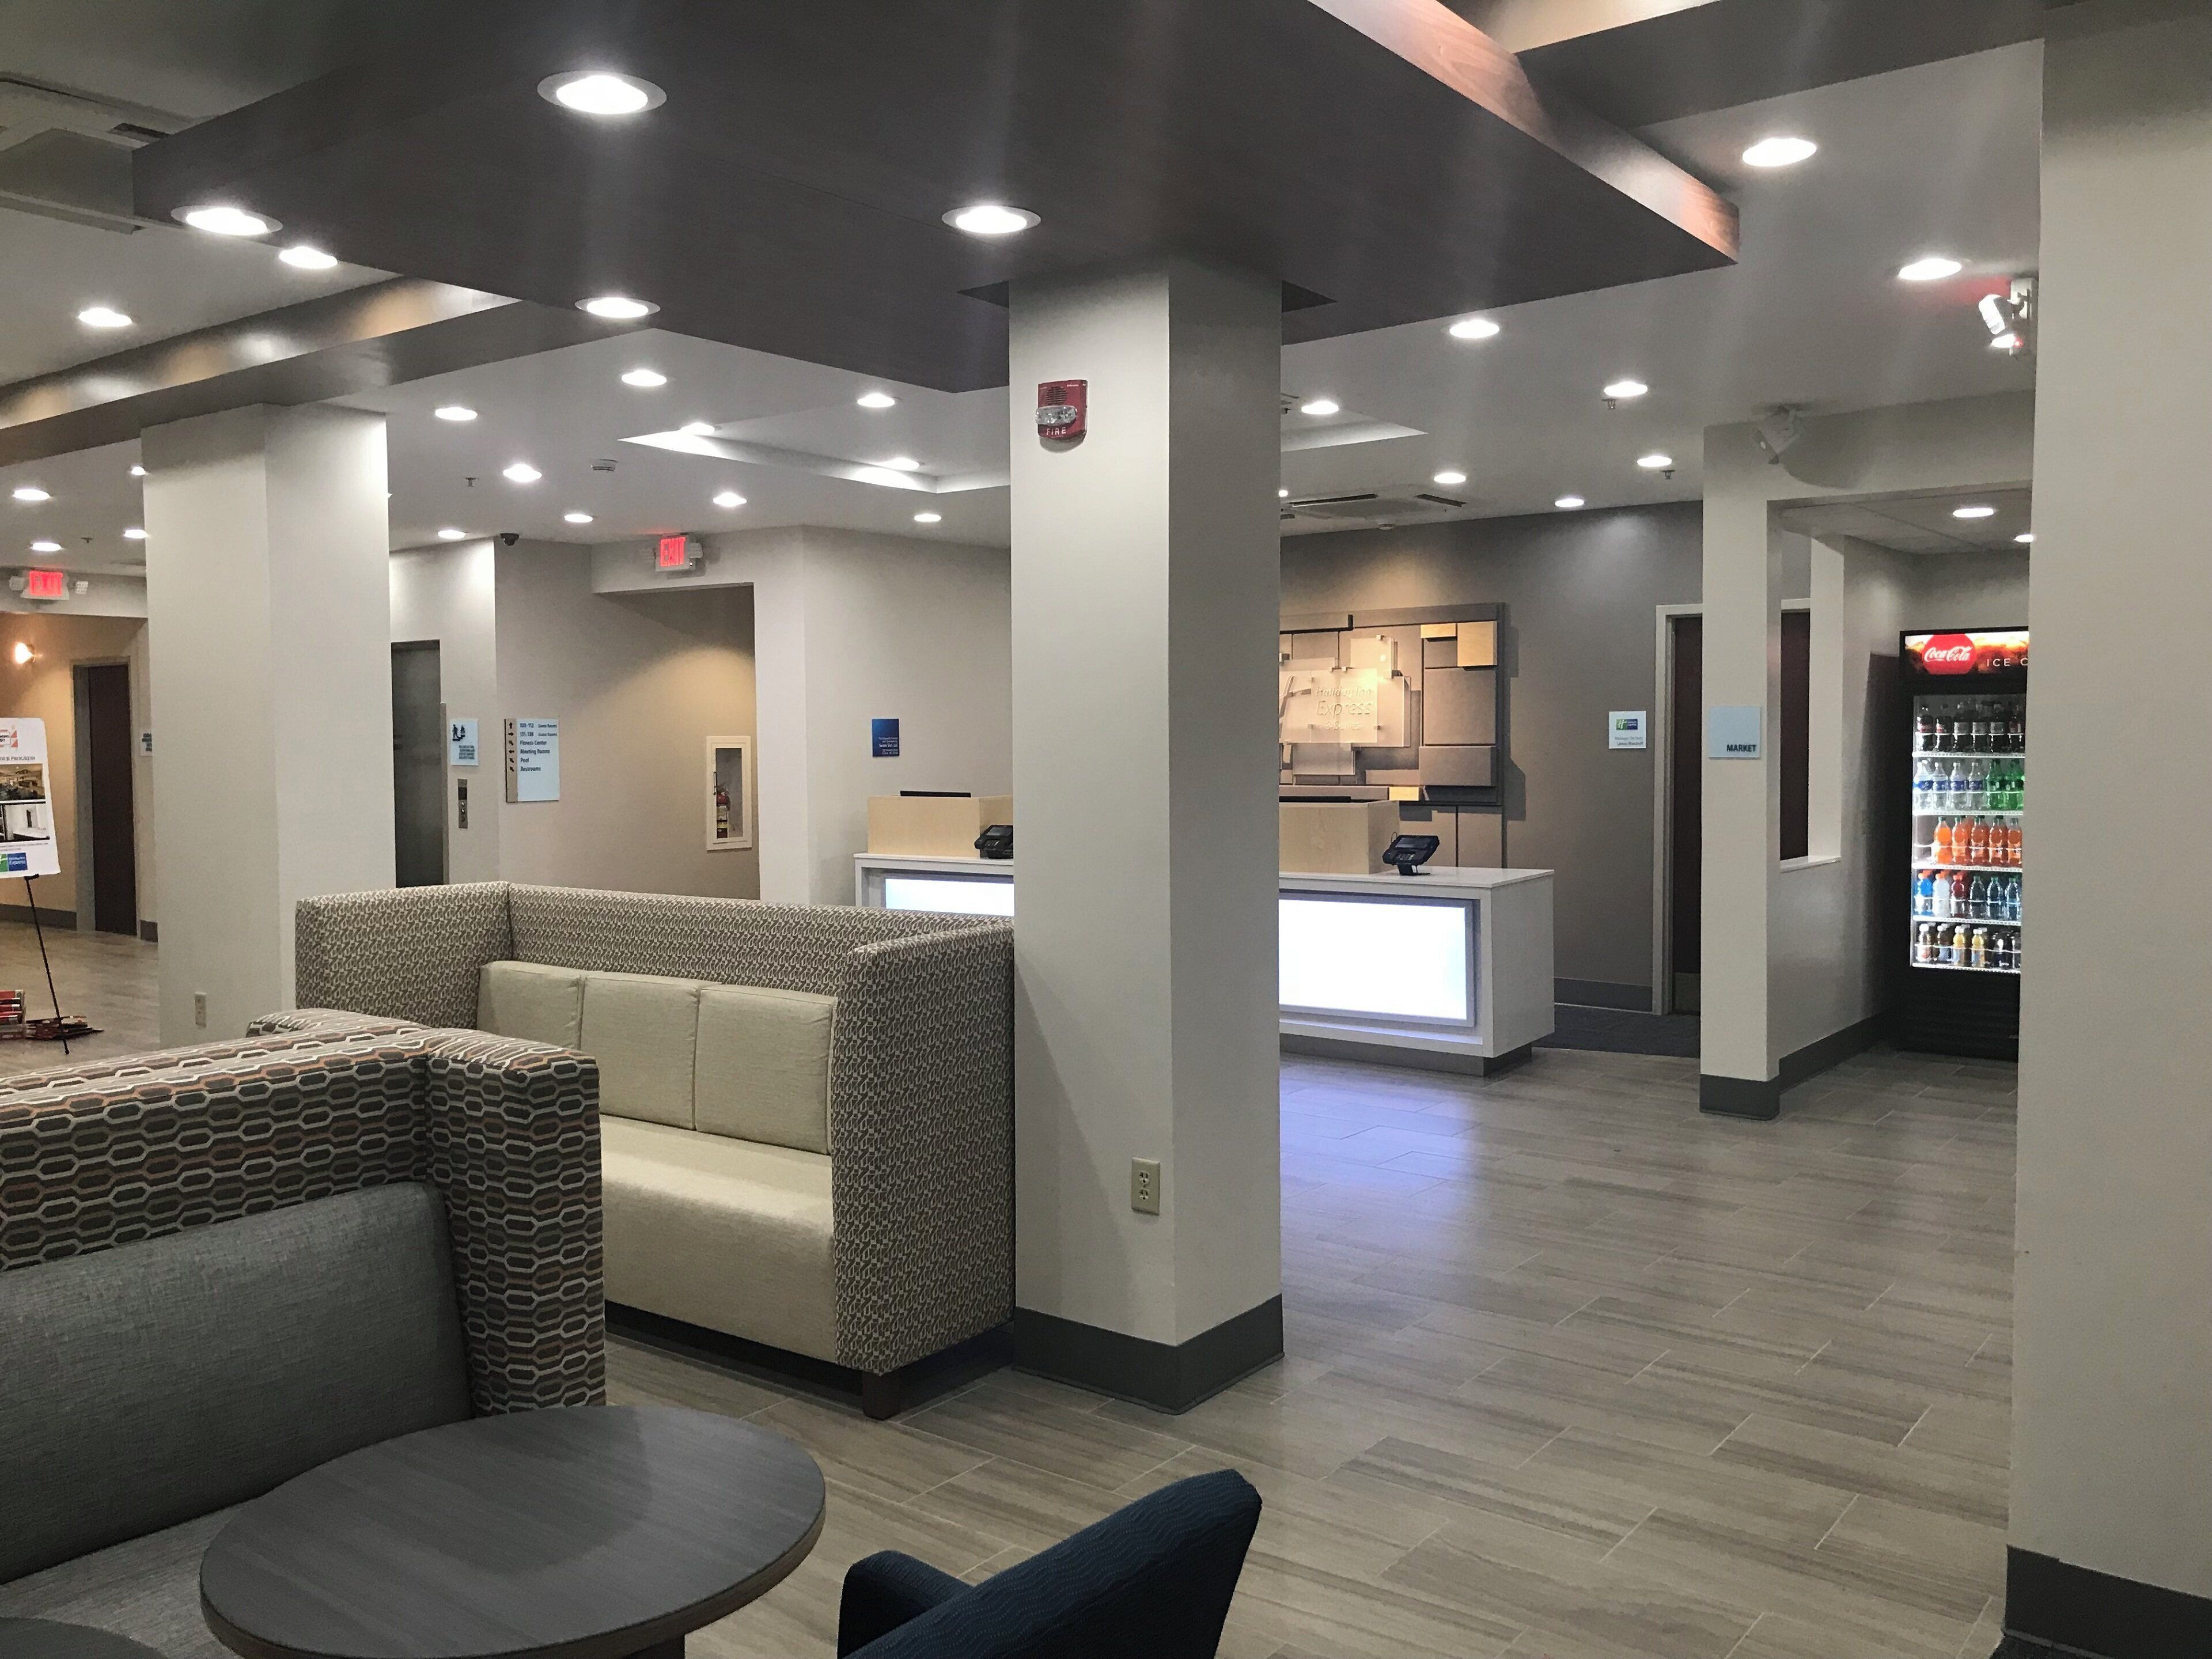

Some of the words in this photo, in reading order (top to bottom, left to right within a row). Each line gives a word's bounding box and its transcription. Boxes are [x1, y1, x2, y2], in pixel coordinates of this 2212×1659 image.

[1046, 426, 1066, 435] FIRE
[660, 536, 686, 567] EXIT
[29, 570, 63, 597] EXIT
[1986, 658, 2011, 666] ICE
[1316, 686, 1354, 699] Holiday
[1317, 700, 1372, 718] Express
[1726, 744, 1756, 752] MARKET
